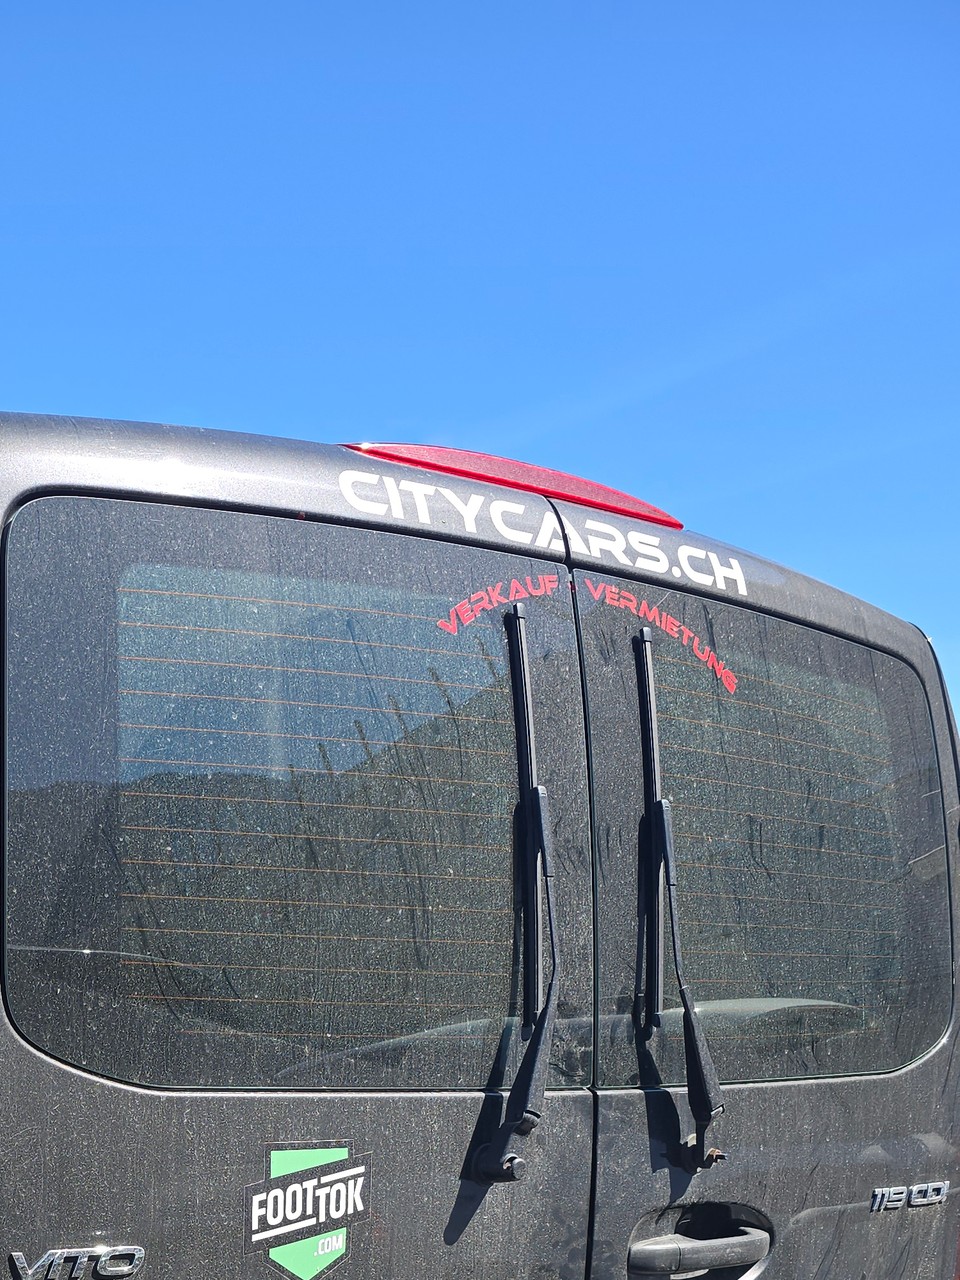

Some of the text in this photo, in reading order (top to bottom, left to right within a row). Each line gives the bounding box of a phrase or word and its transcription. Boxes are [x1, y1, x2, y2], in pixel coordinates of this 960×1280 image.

[340, 469, 747, 596] CITYCARS.CH
[437, 574, 559, 635] VERKAUF
[584, 578, 738, 694] VERMIETUNG
[251, 1177, 365, 1230] FOOTTOK
[871, 1181, 950, 1212] 119 CDI
[313, 1234, 344, 1257] .COM
